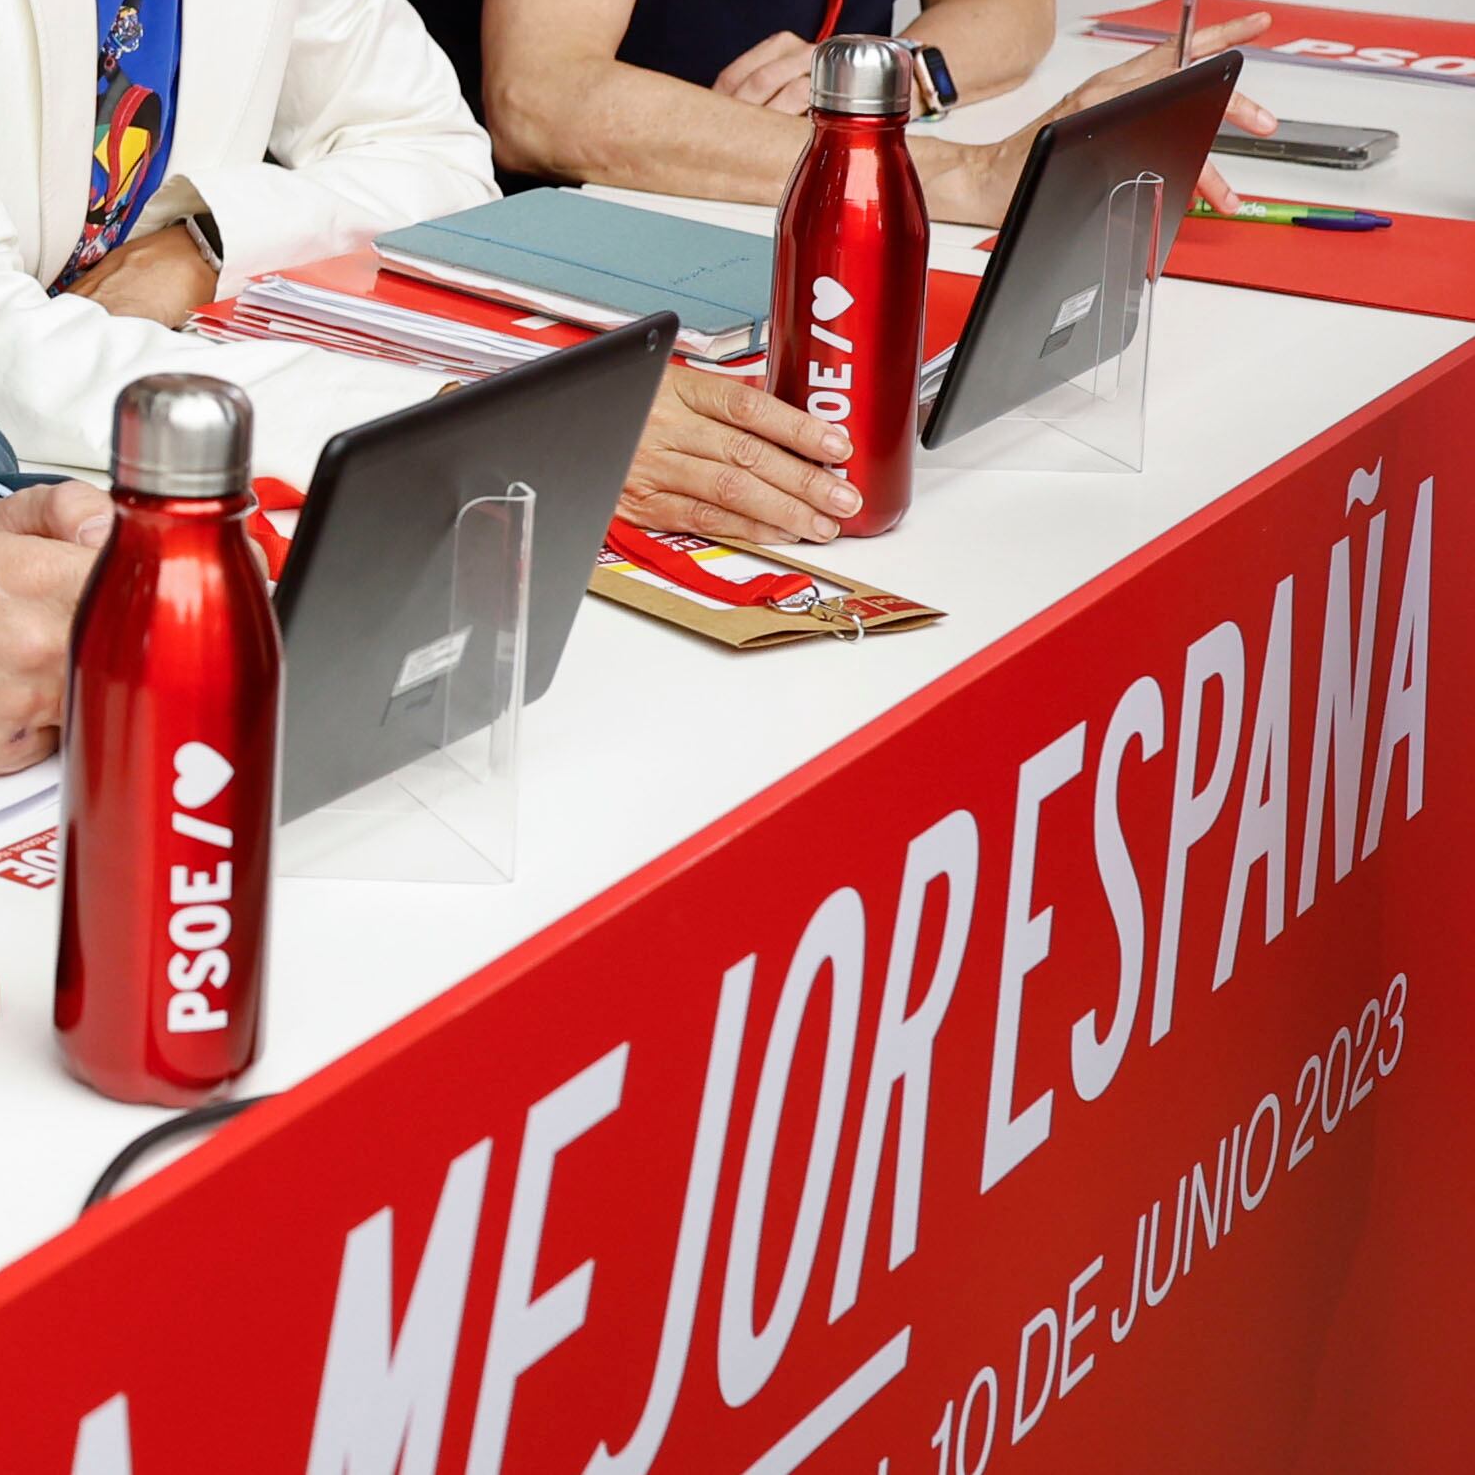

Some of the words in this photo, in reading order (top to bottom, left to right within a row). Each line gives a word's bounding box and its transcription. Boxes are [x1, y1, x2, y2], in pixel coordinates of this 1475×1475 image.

[806, 360, 853, 480] OE
[166, 859, 233, 1033] PSOE
[305, 808, 981, 1475] MEJOR
[980, 456, 1436, 1195] ESPAÑA
[1011, 1254, 1104, 1446] DE
[1110, 1091, 1281, 1344] JUNIO
[1287, 969, 1409, 1173] 2023
